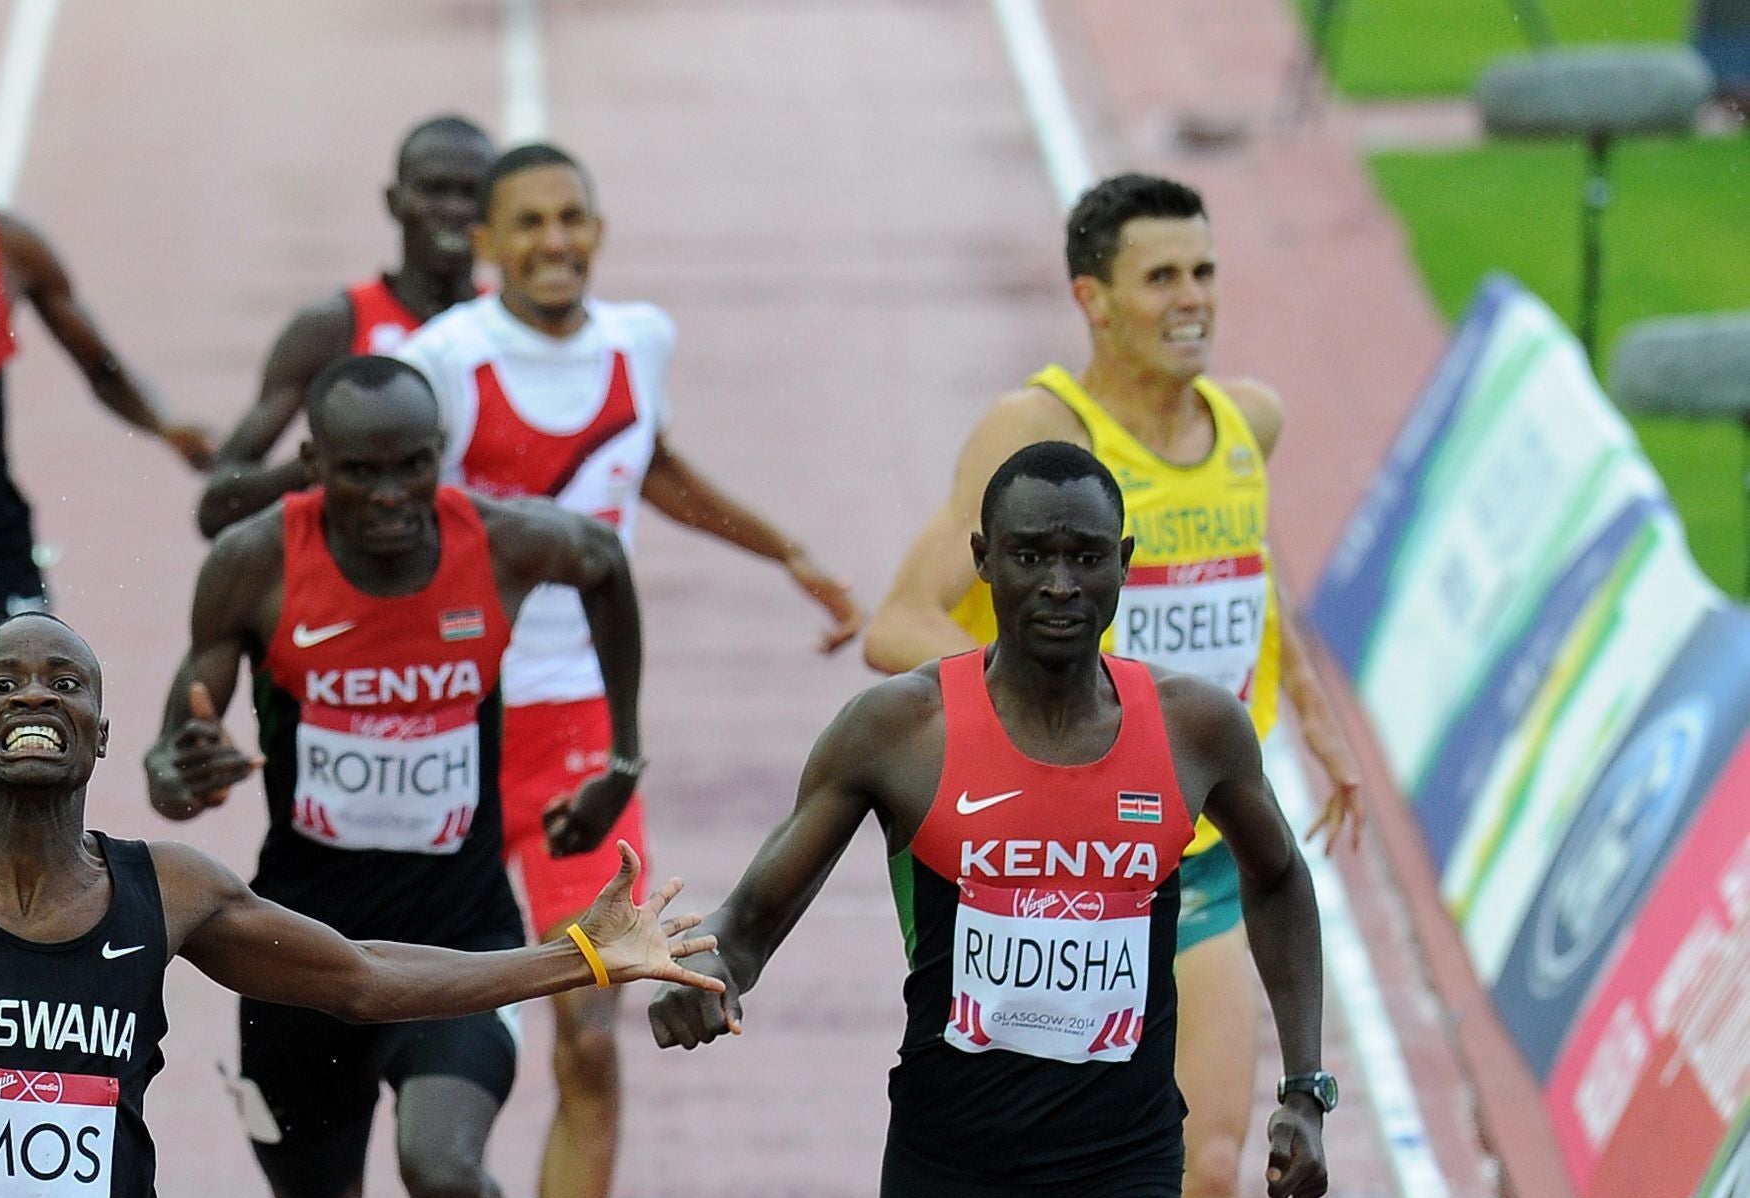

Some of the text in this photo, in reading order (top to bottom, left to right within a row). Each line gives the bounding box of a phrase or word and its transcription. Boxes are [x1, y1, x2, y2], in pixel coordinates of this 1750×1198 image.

[1127, 596, 1263, 654] RISELEY
[305, 660, 482, 706] KENYA
[309, 745, 470, 796] ROTICH
[961, 840, 1158, 882] KENYA
[964, 927, 1136, 991] RUDISHA
[991, 1011, 1096, 1030] GLASGOW 2014
